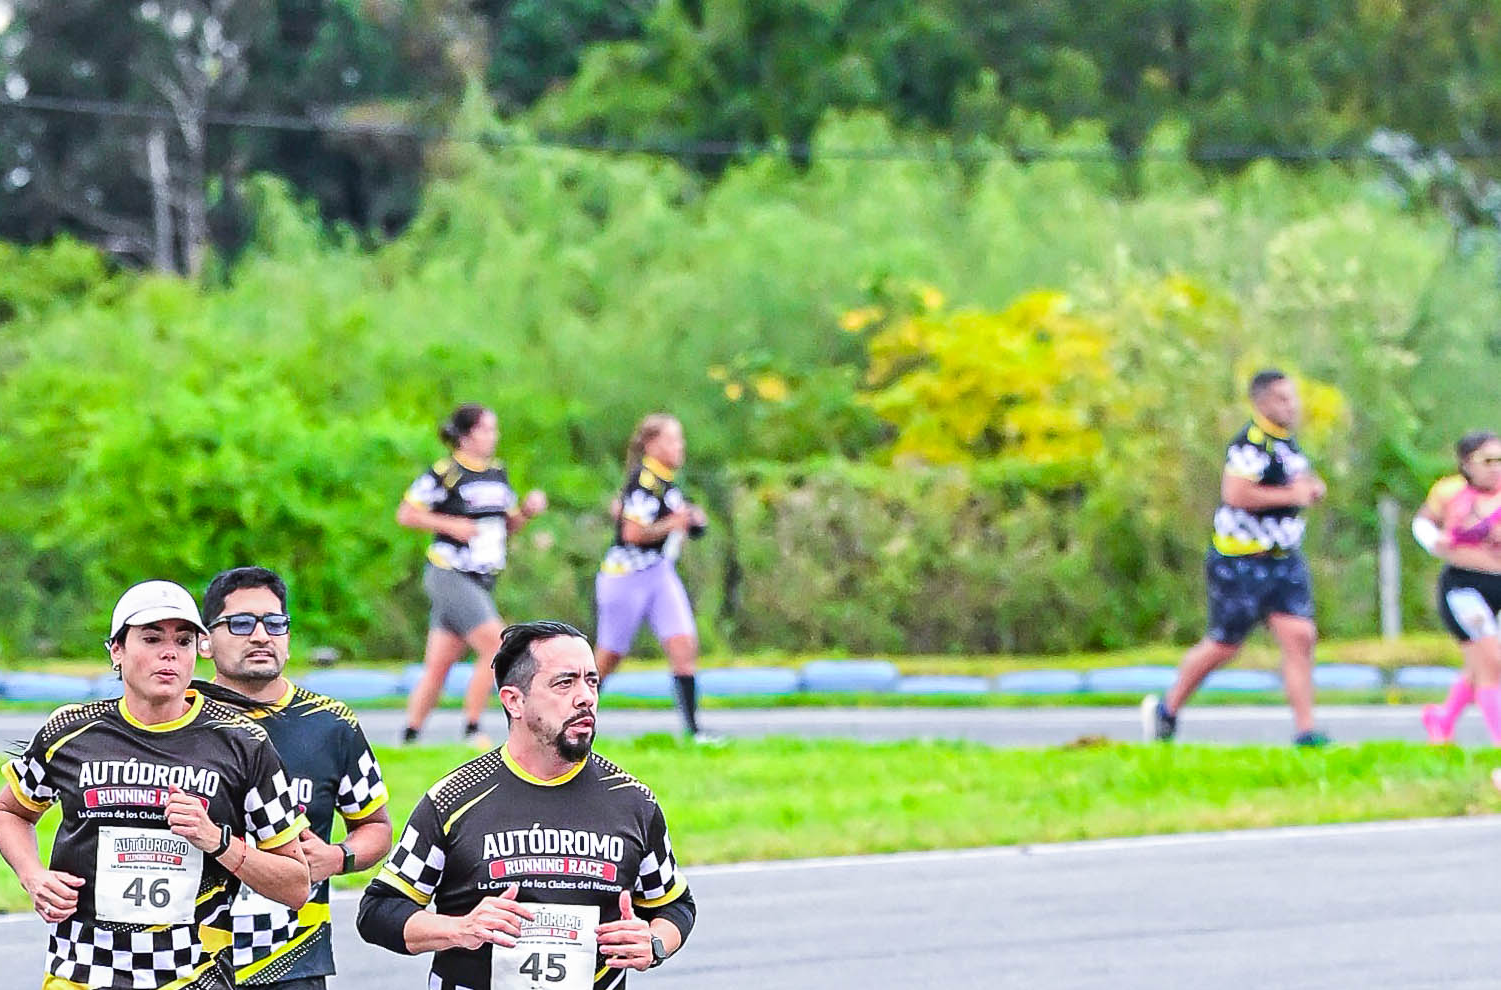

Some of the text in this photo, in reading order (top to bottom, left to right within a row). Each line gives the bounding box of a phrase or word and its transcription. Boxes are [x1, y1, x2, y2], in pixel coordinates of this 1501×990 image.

[78, 757, 220, 798] AUTÓDROMO
[97, 788, 157, 805] RUNNING
[77, 810, 166, 820] La Carrera de los Clubes
[114, 834, 190, 856] AUTÓDROMO
[481, 822, 625, 863] AUTÓDROMO
[503, 858, 605, 878] RUNNING RACE
[122, 877, 171, 908] 46
[478, 881, 488, 890] La
[521, 879, 533, 888] de
[534, 879, 547, 889] los
[548, 880, 576, 889] Clubes
[577, 880, 592, 890] del
[519, 952, 567, 982] 45
